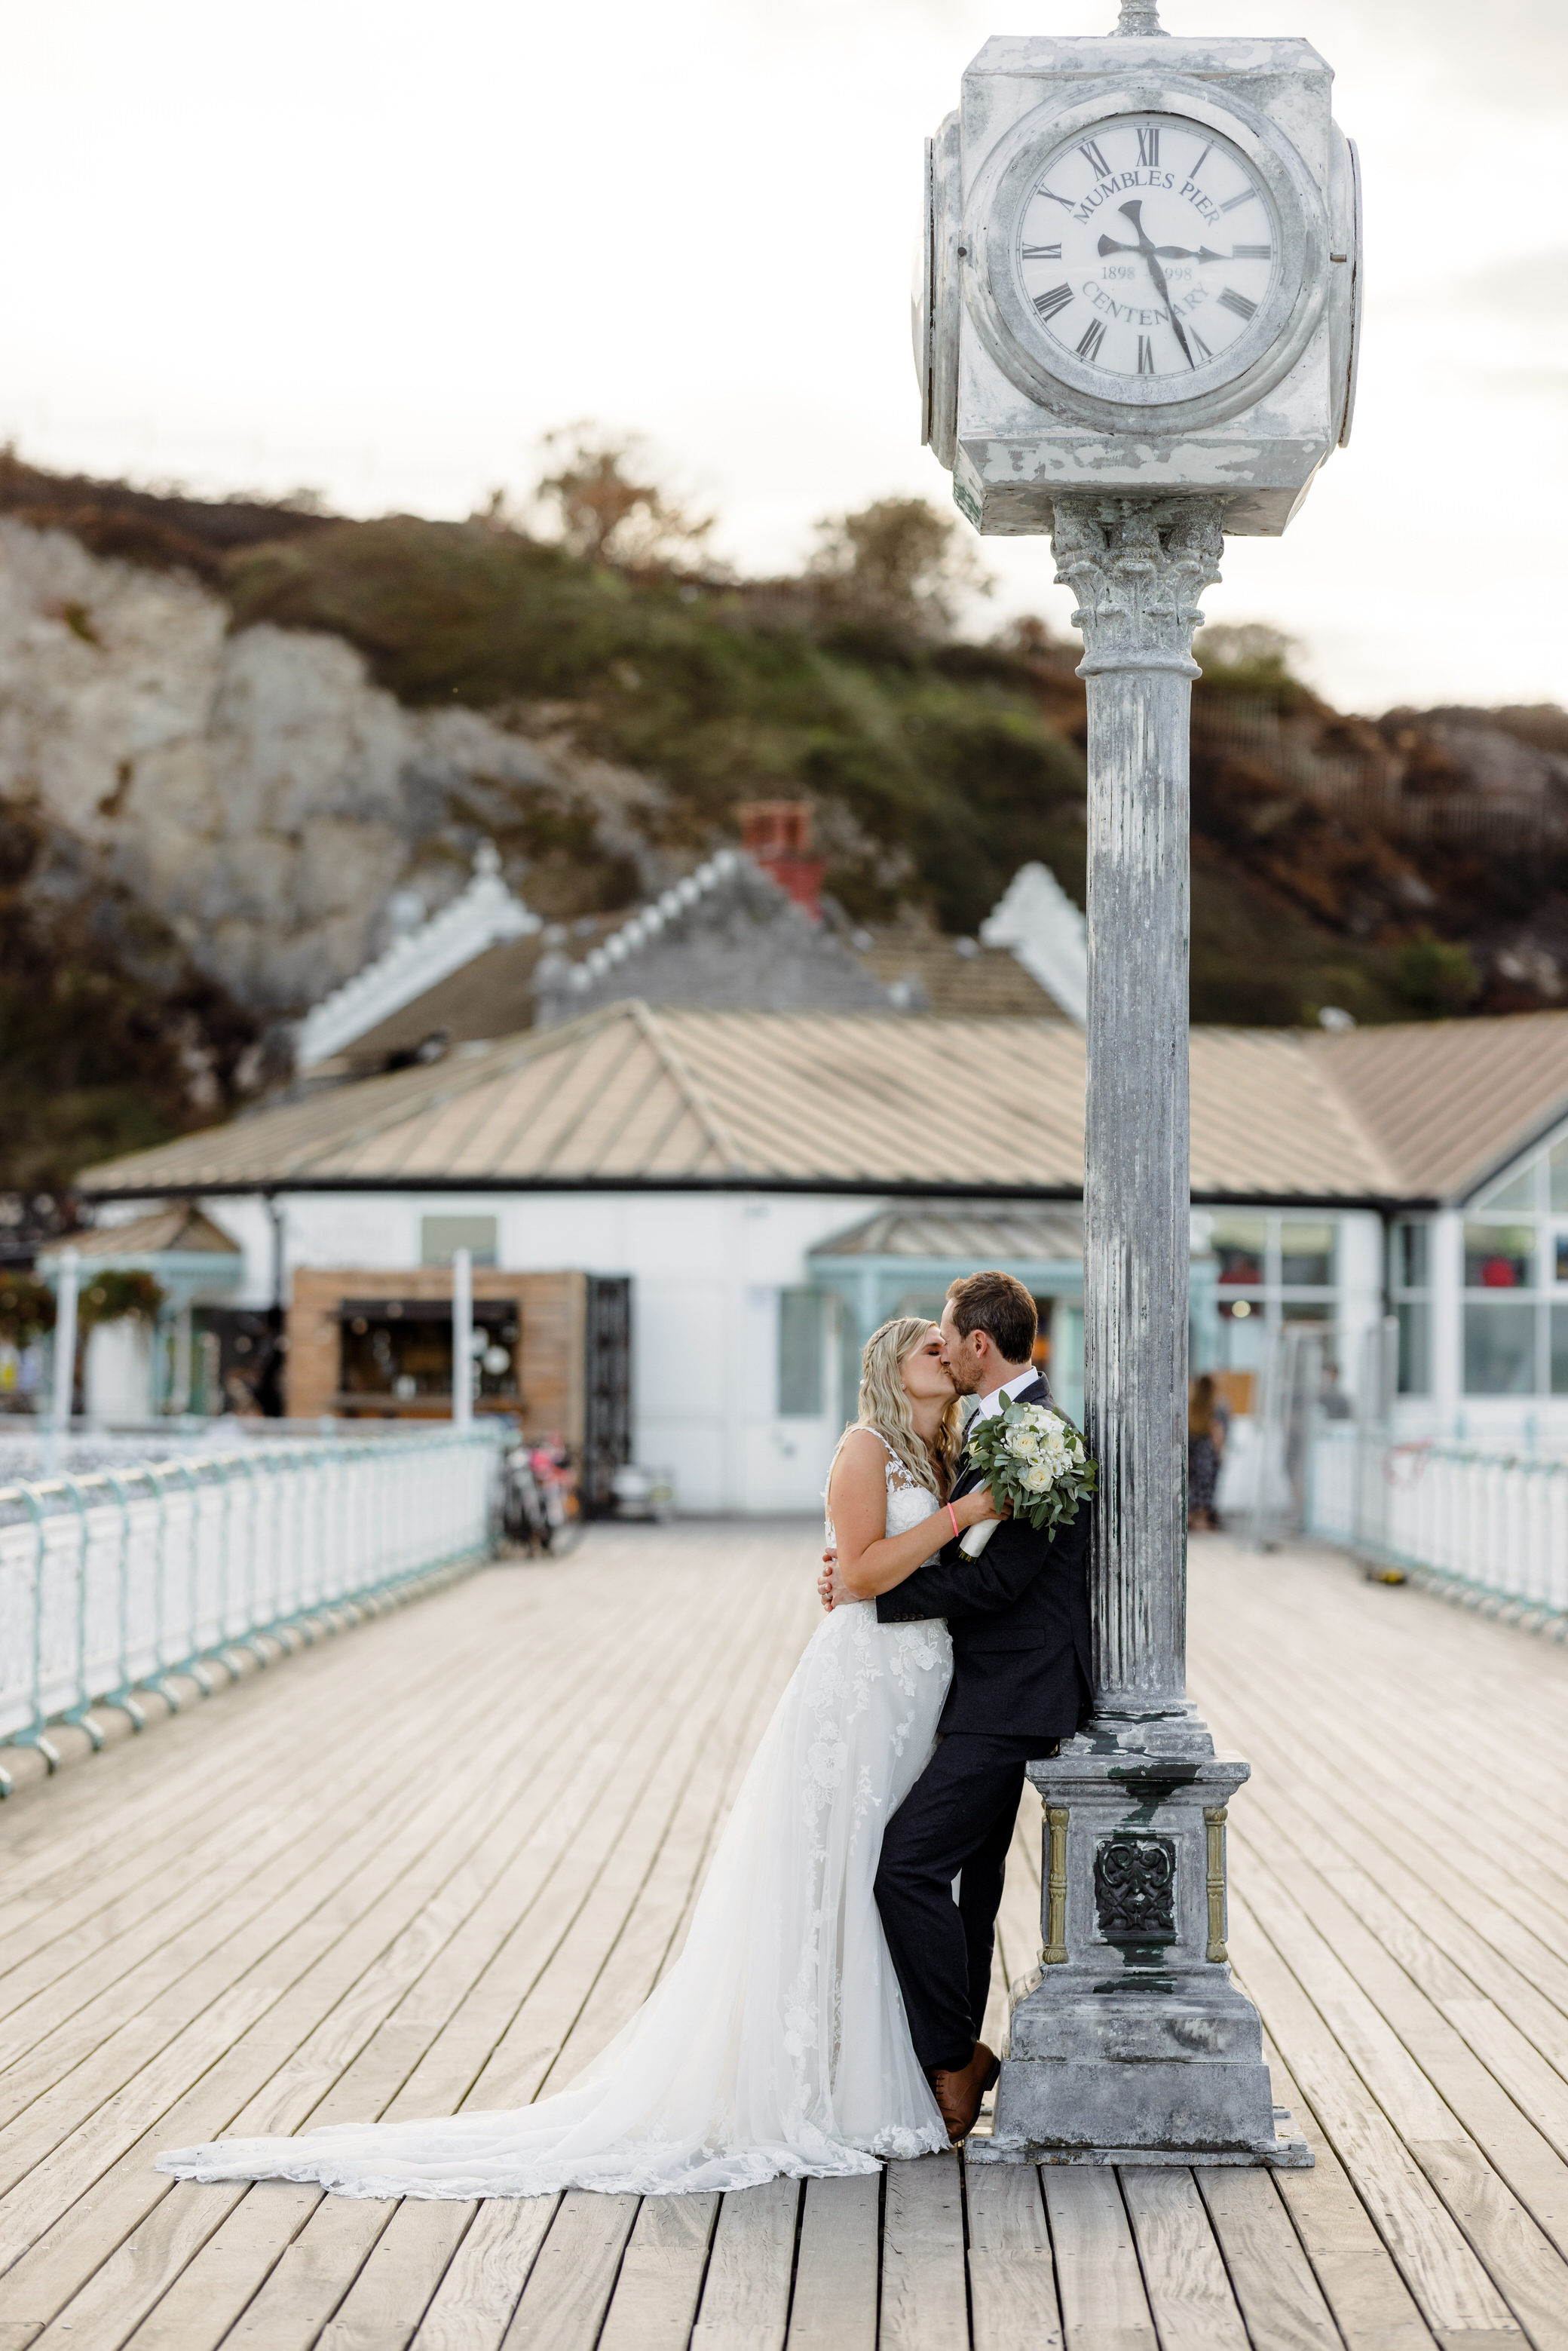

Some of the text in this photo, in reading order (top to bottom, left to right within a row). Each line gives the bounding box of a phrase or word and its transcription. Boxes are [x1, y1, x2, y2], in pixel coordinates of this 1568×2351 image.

[1078, 140, 1113, 182] XI
[1135, 128, 1160, 167] XII
[1188, 144, 1212, 180] I
[1037, 183, 1076, 213] X
[1073, 170, 1220, 227] MUMBLES PIER
[1219, 188, 1257, 213] II
[1022, 242, 1061, 261] IX
[1233, 244, 1271, 260] III
[1101, 266, 1192, 281] 1898 998
[1083, 280, 1209, 326] CENTENARY
[1136, 336, 1156, 375] VI
